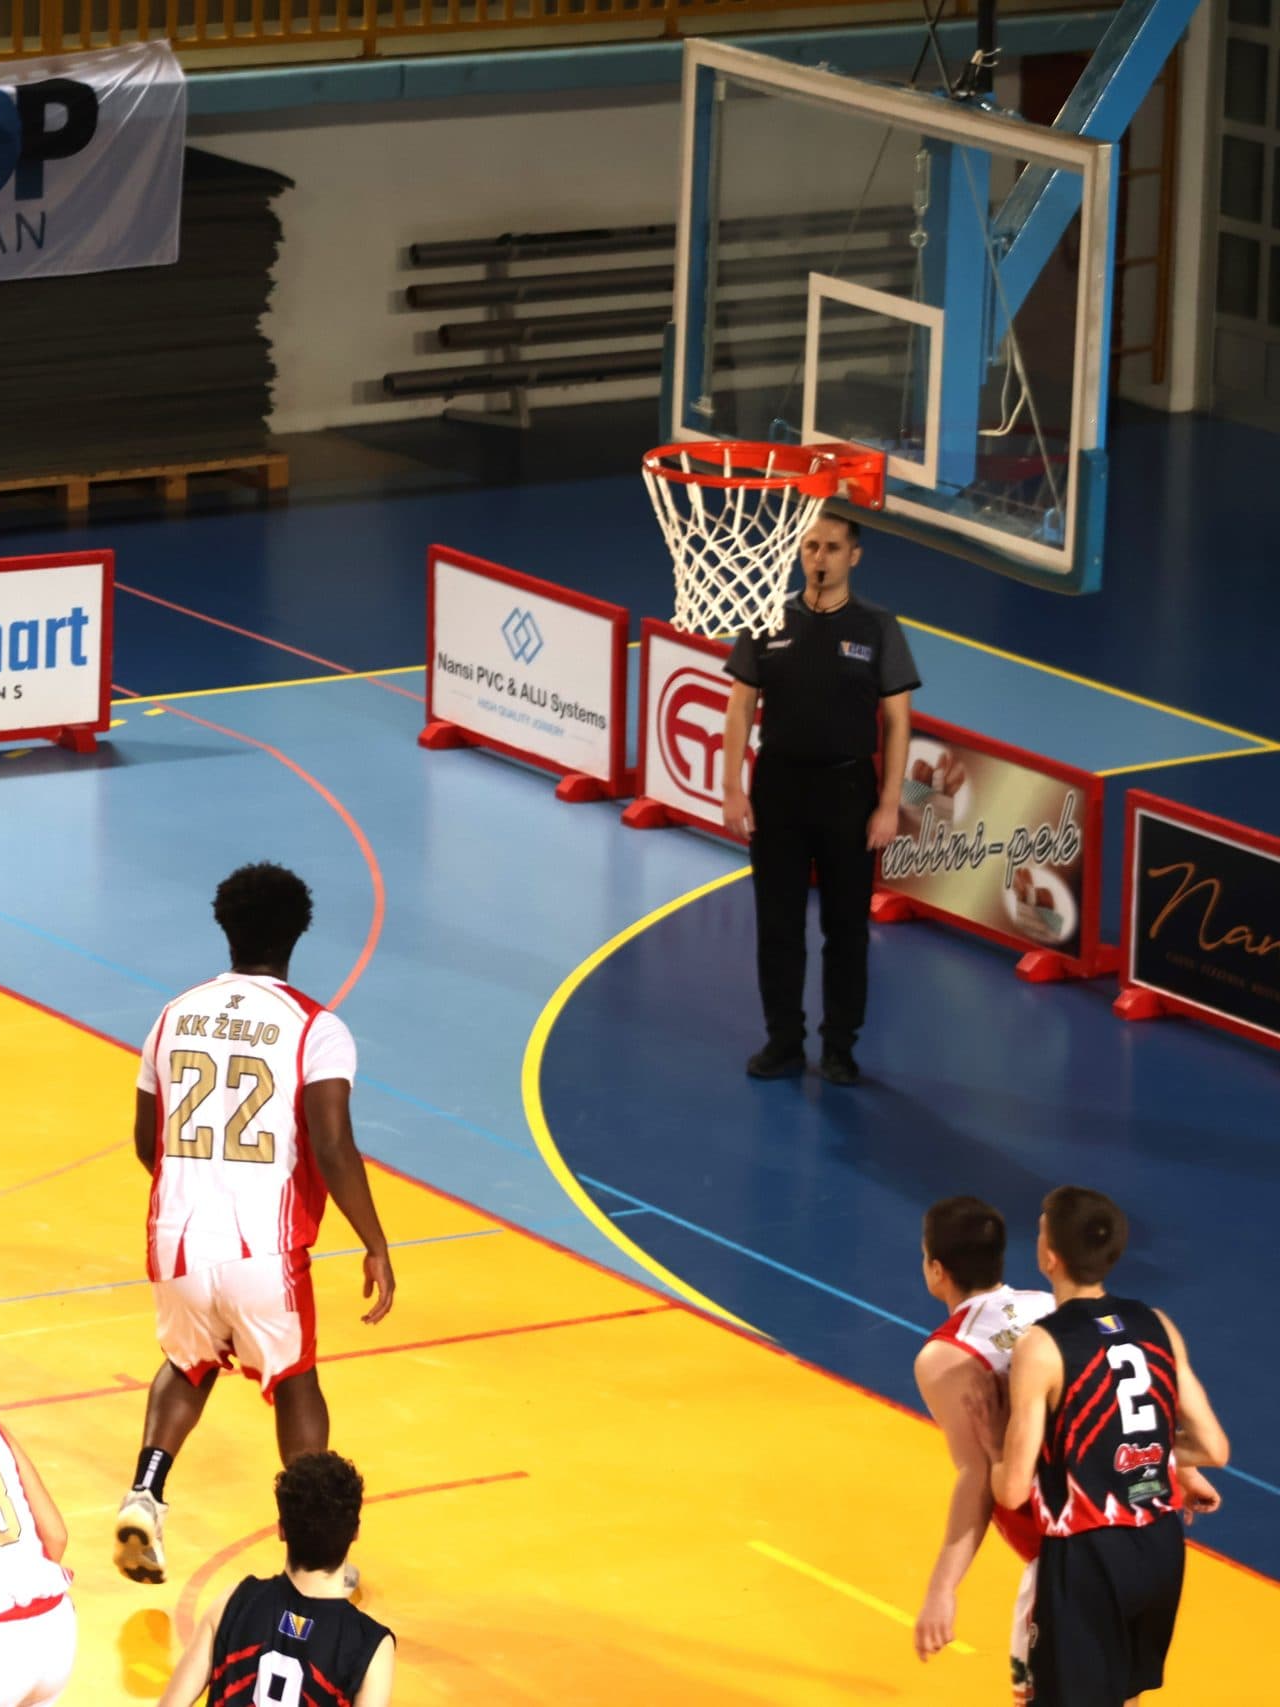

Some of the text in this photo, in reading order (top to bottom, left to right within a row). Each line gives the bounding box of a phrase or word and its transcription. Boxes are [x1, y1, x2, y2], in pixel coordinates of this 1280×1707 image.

[437, 652, 608, 730] Nansi PVC & ALU Systems
[176, 1013, 280, 1047] KK ŽELJO
[166, 1050, 276, 1163] 22
[1106, 1343, 1158, 1435] 2
